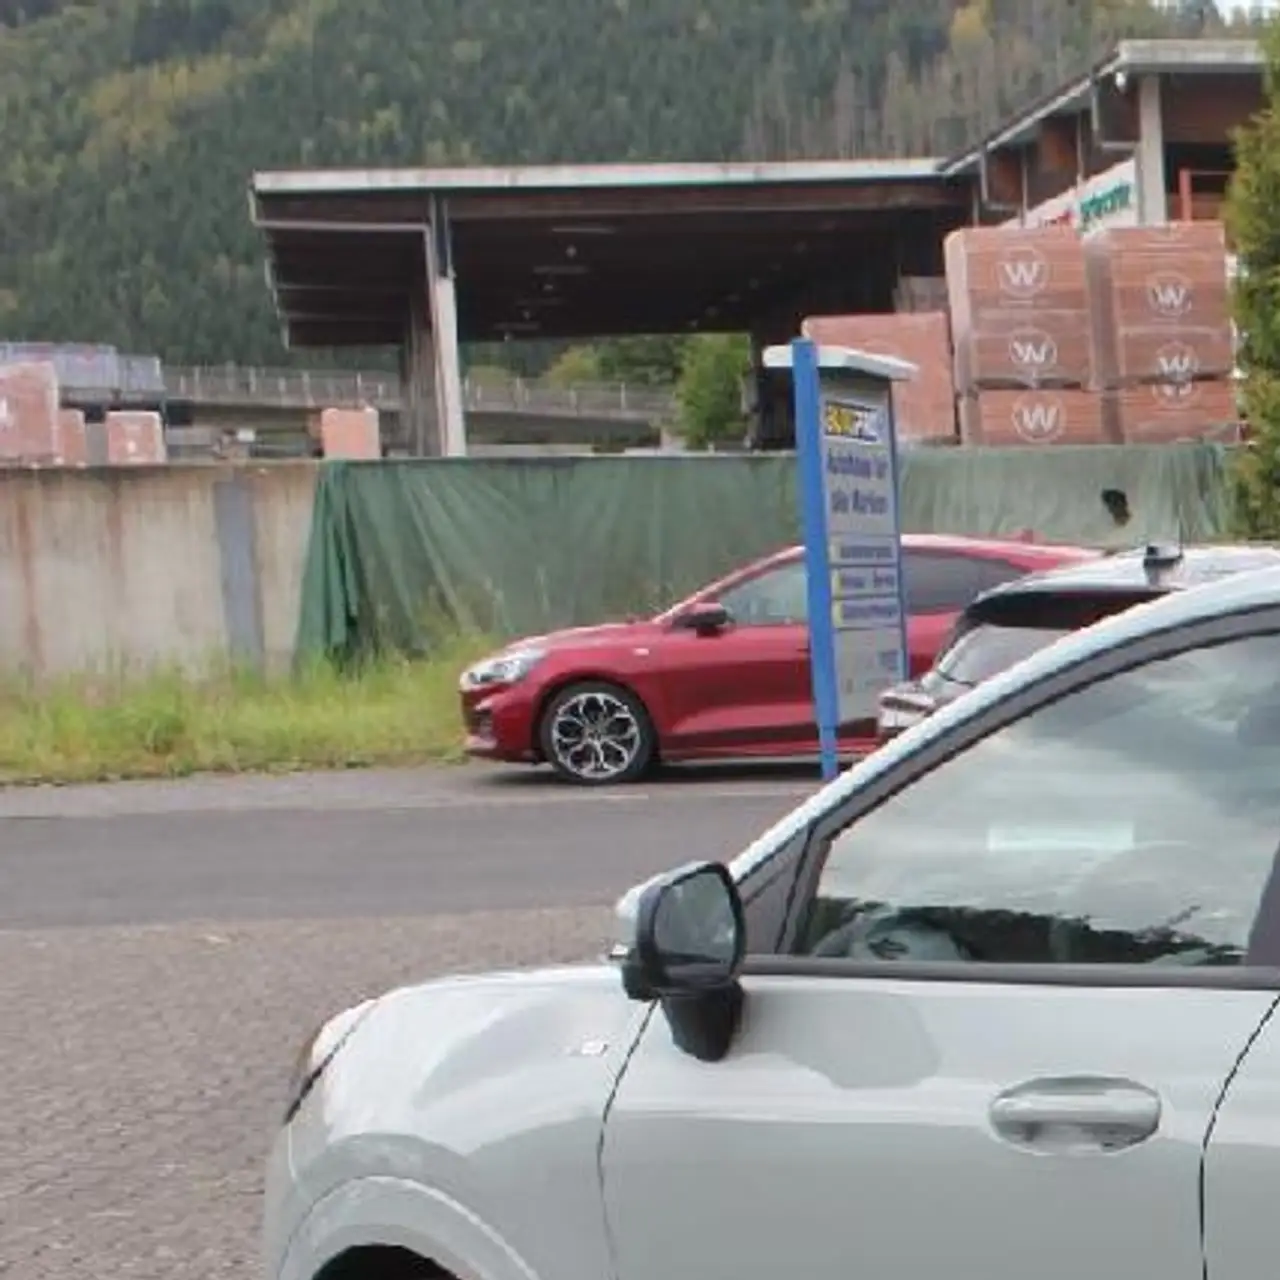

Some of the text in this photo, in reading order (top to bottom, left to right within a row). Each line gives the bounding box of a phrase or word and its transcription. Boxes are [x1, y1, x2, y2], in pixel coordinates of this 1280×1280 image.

[1004, 261, 1040, 286] W
[1154, 284, 1187, 308] W
[1012, 340, 1047, 363] W
[1022, 404, 1058, 431] W
